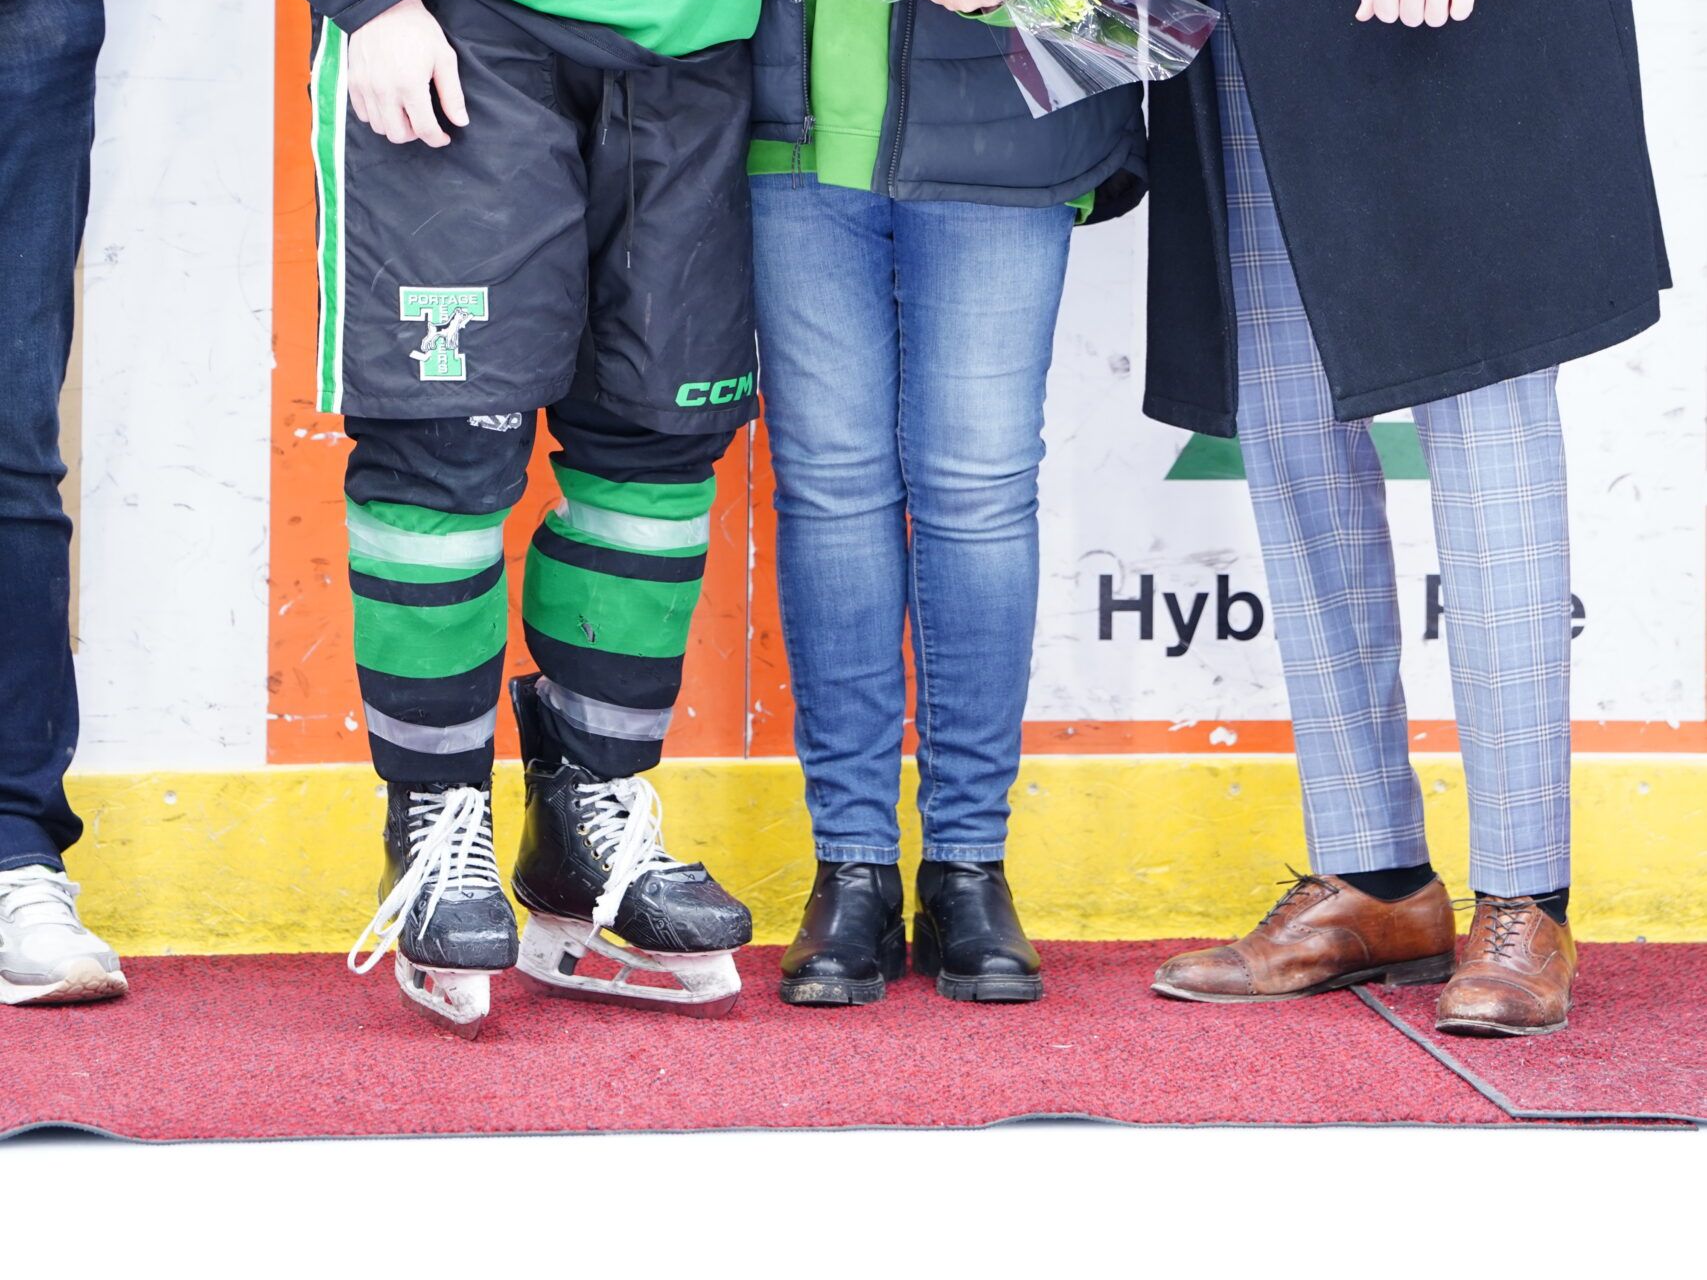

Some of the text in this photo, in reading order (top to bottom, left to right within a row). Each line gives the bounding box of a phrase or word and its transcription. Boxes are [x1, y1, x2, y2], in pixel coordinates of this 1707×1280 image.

[408, 294, 480, 306] PORTAGE
[675, 371, 753, 407] CCM
[1099, 574, 1278, 657] Hyb
